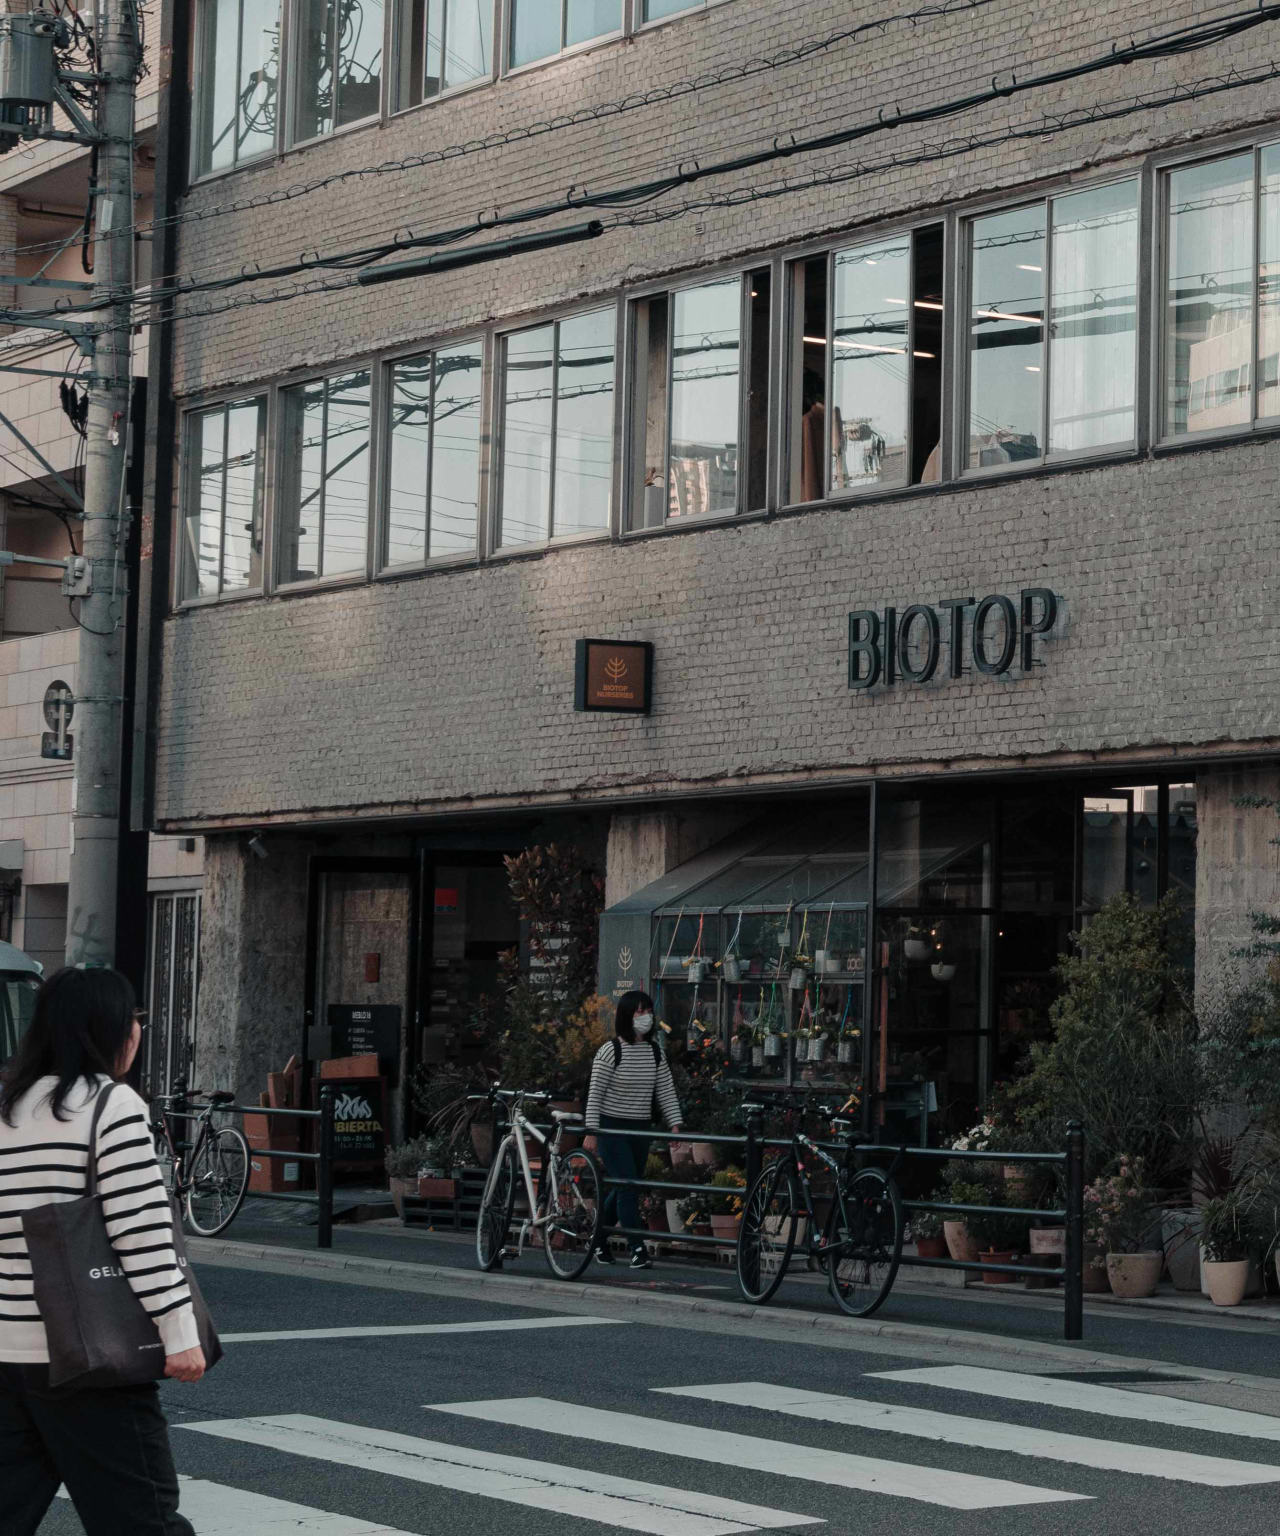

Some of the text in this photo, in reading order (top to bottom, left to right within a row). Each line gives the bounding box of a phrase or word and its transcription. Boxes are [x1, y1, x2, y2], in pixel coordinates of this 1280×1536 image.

[848, 587, 1058, 689] BIOTOP
[603, 684, 629, 692] BIOTOP
[333, 1120, 384, 1134] BIERTA
